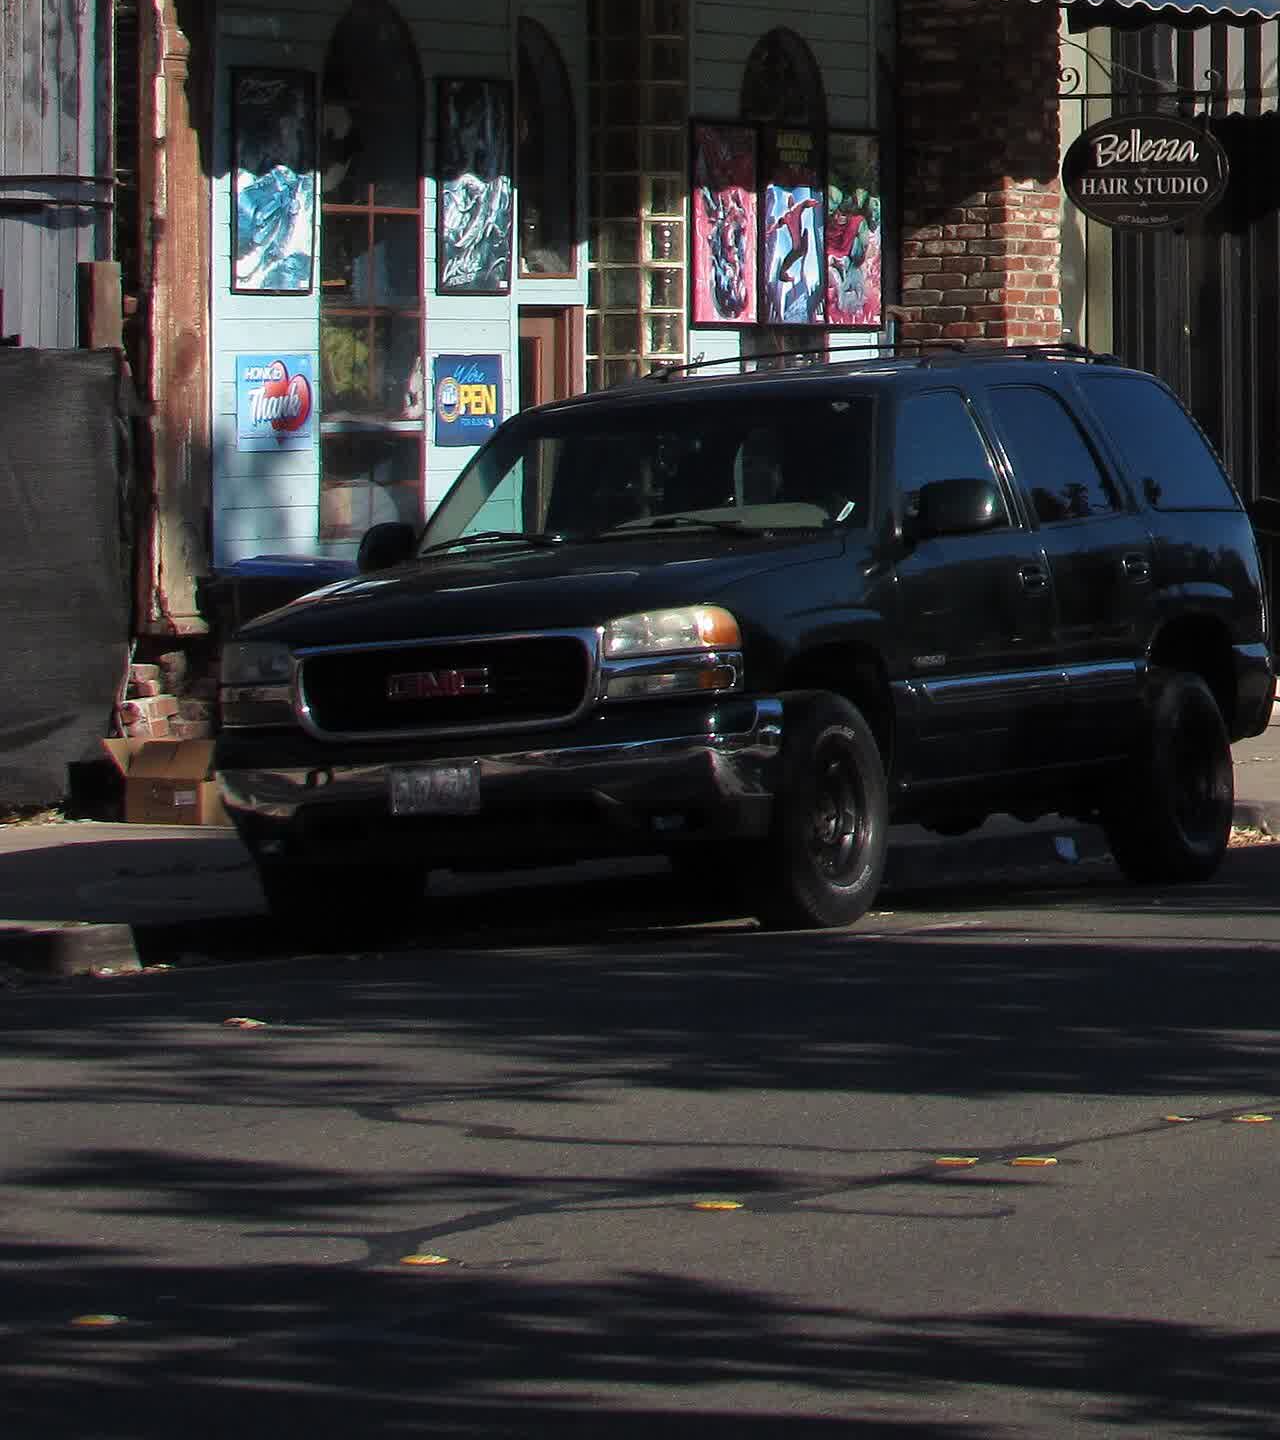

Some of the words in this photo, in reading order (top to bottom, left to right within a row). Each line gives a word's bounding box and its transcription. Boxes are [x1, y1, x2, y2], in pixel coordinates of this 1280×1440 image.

[1091, 128, 1199, 168] Bellezza
[1080, 177, 1129, 195] HAIR
[1133, 176, 1209, 195] STUDIO
